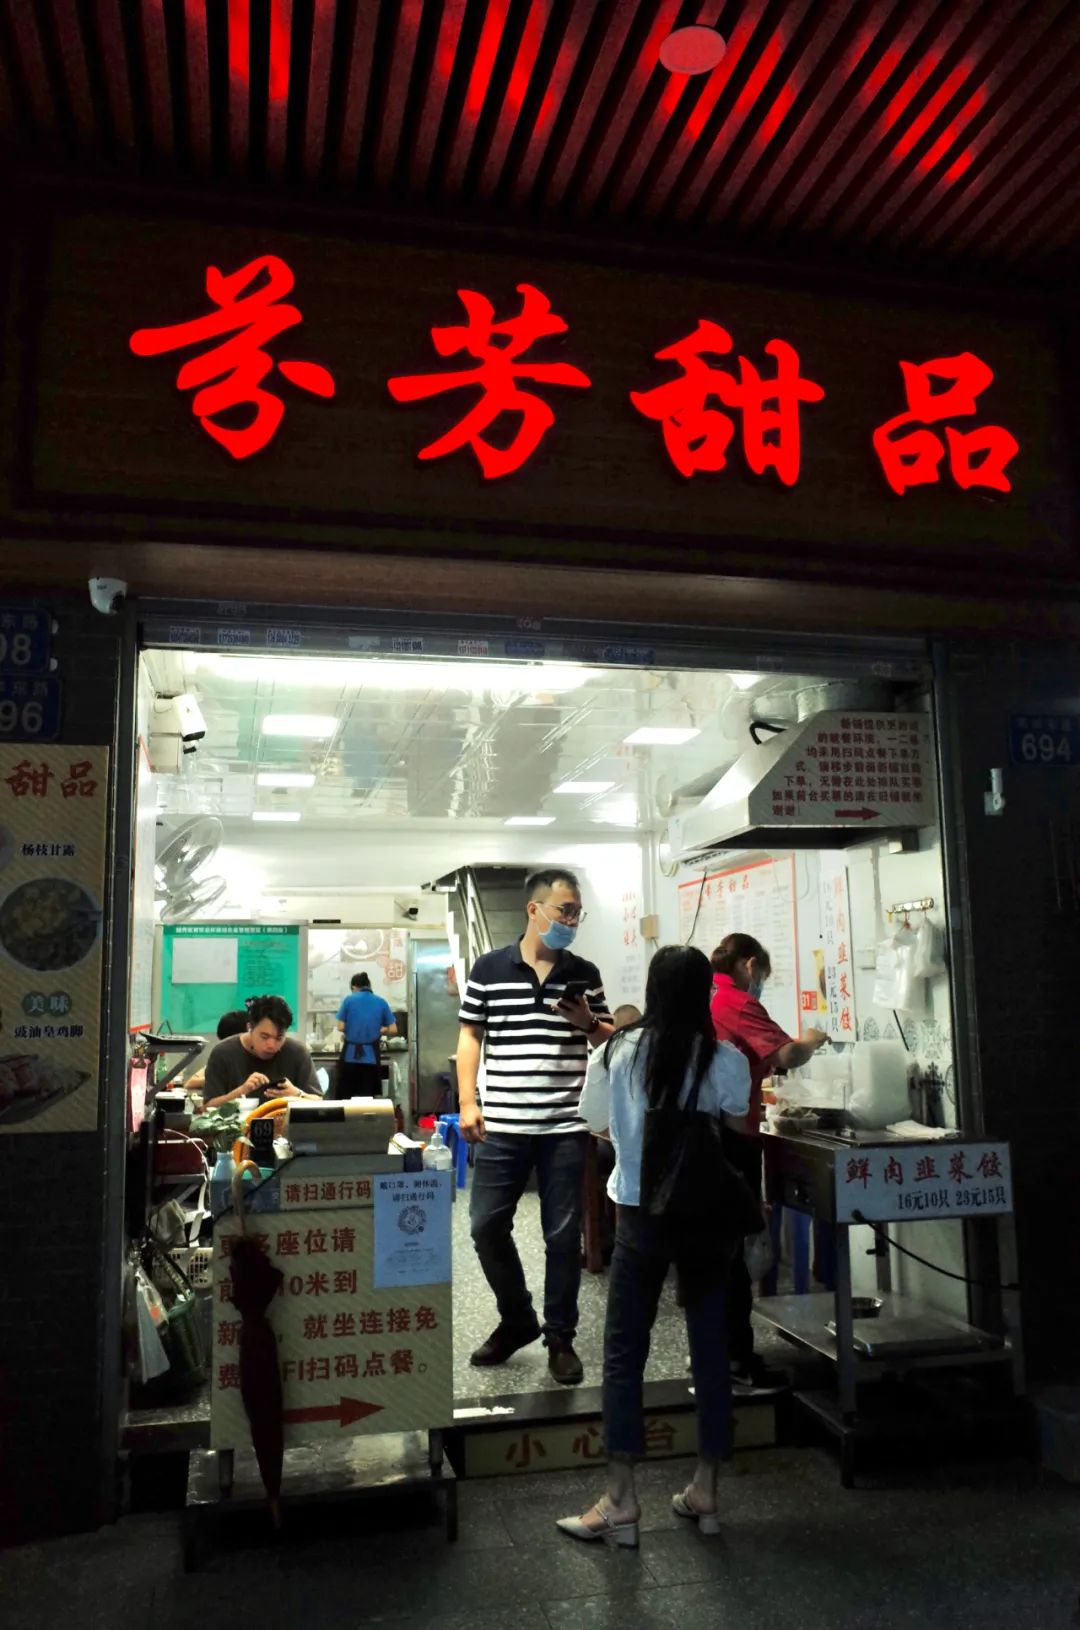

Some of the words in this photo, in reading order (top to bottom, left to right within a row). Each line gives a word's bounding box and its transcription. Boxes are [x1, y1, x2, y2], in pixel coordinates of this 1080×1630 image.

[129, 254, 1020, 495] 芬芳甜品
[1021, 732, 1071, 762] 694
[4, 759, 98, 798] 甜品
[22, 843, 75, 856] 杨枝甘露
[28, 994, 68, 1013] 美味
[845, 1151, 1004, 1189] 鲜肉韭菜饺
[285, 1180, 371, 1203] 请扫通行码
[897, 1189, 951, 1211] 16元10只
[505, 1419, 739, 1468] 小心台
